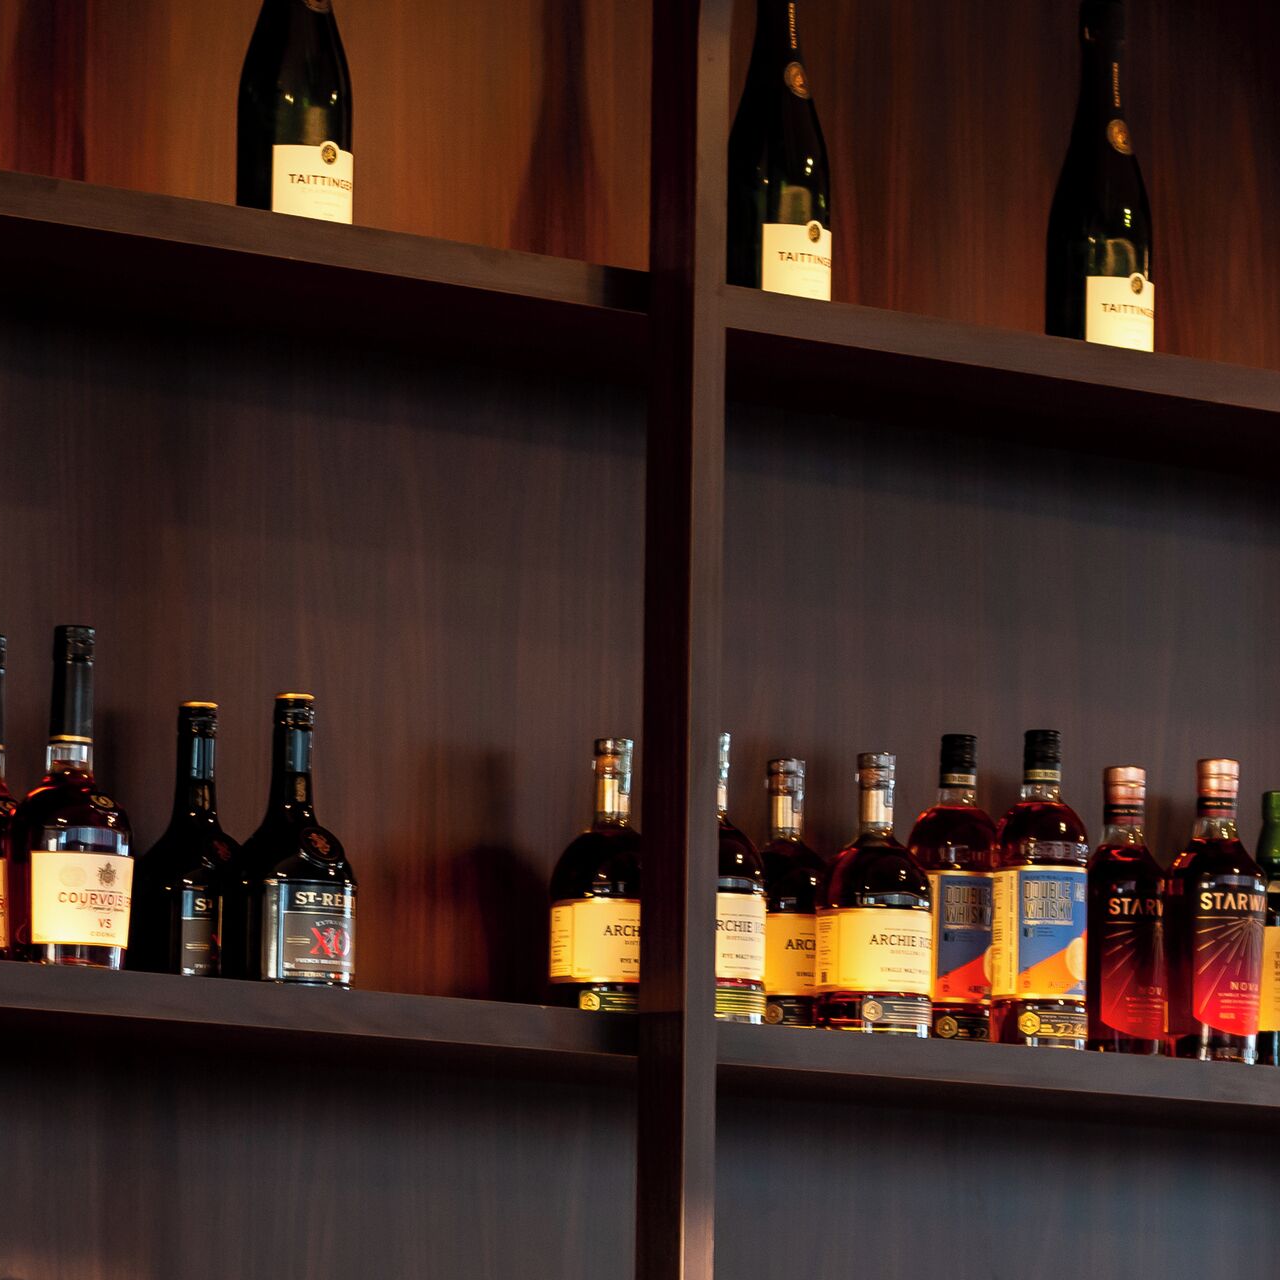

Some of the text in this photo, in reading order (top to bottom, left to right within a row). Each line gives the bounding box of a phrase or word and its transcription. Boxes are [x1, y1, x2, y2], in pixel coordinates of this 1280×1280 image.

[1022, 879, 1071, 901] DOUBLE
[1022, 898, 1074, 922] WHISKY
[1200, 892, 1266, 913] STARWA
[98, 918, 113, 930] VS
[869, 933, 917, 949] ARCHIE
